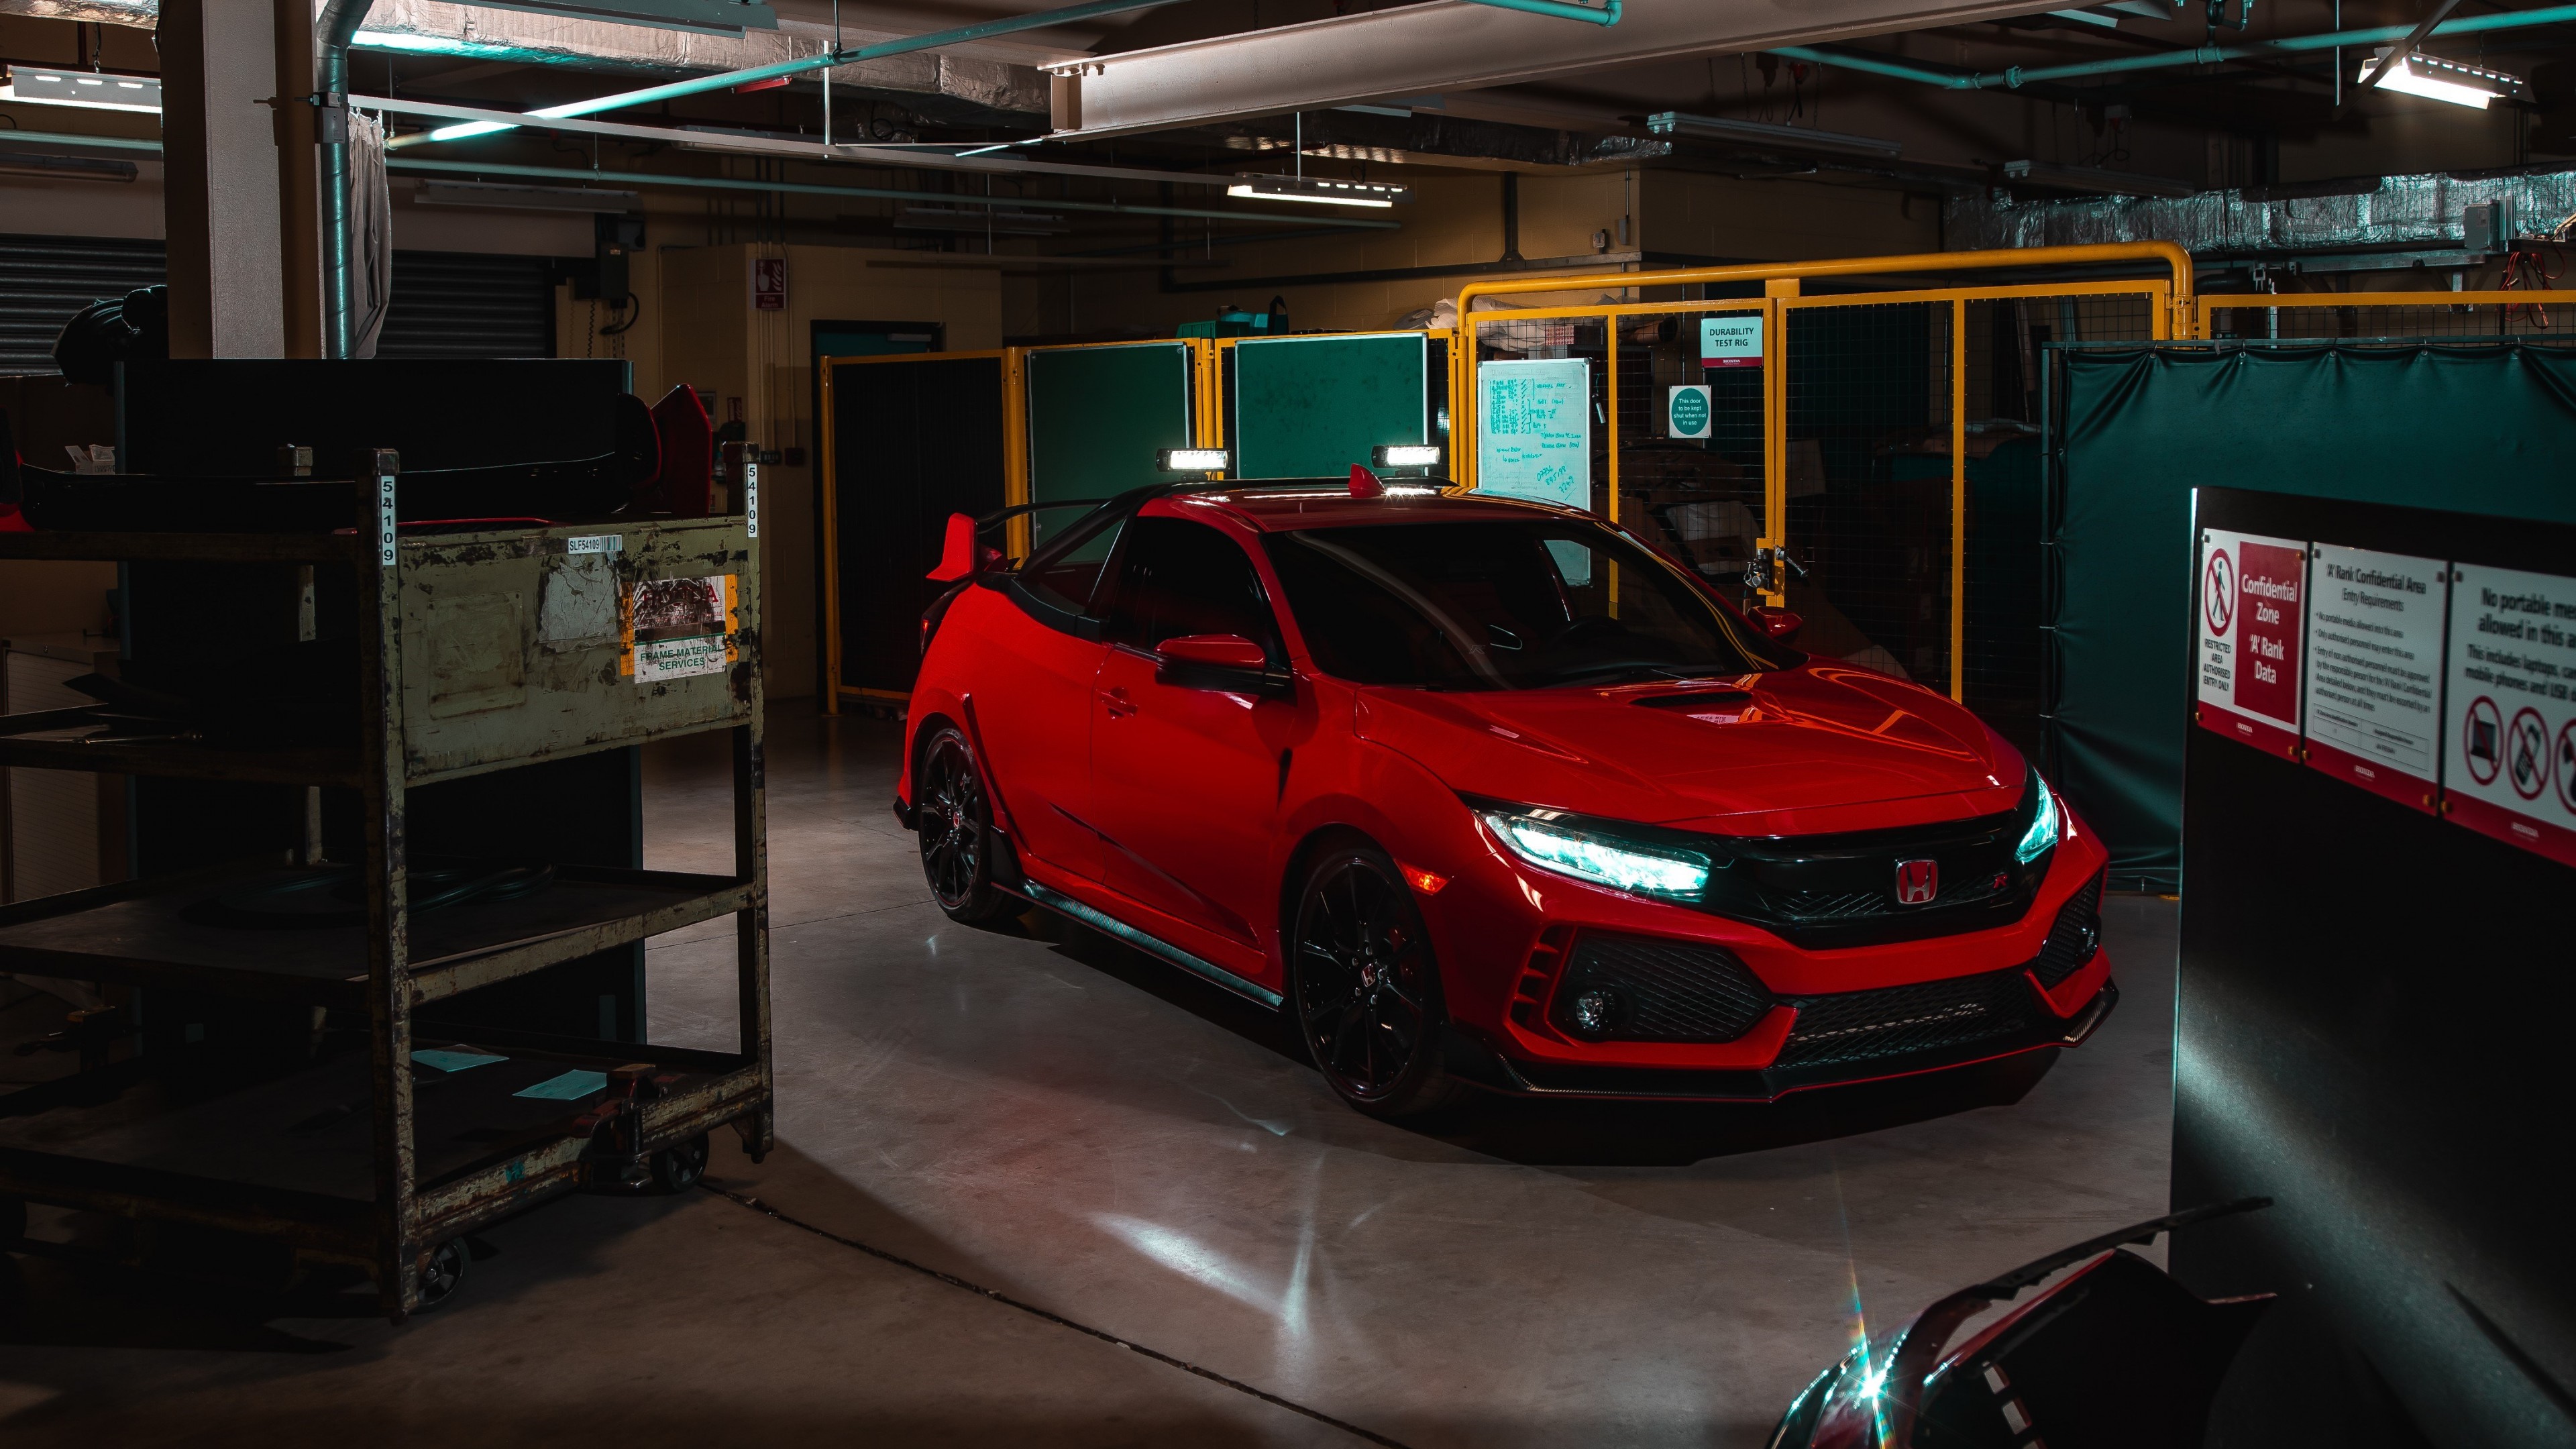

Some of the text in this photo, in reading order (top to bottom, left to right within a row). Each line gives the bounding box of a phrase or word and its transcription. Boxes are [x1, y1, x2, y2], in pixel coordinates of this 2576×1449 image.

[1709, 327, 1754, 335] DURABILITY
[748, 468, 757, 534] 54109
[382, 481, 394, 561] 54109
[569, 539, 600, 551] SLF54109
[2241, 574, 2298, 602] Confidential
[2336, 565, 2355, 582] Rank
[2356, 568, 2404, 590] Confidential
[2406, 576, 2426, 594] Area
[2341, 588, 2404, 612] Entry Requirements
[2481, 586, 2498, 608] No
[2499, 593, 2551, 616] portable
[2256, 602, 2279, 625] Zone
[2318, 611, 2325, 621] No
[2325, 614, 2343, 625] portable
[2343, 617, 2356, 628] media
[2357, 619, 2373, 631] allowed
[2384, 625, 2393, 636] this
[2478, 613, 2524, 639] allowed
[2526, 619, 2538, 641] in
[2540, 623, 2564, 647] this
[640, 644, 723, 661] FRAME MATERIAL
[2204, 639, 2231, 654] RESTRICTED
[2261, 636, 2284, 660] Rank
[2318, 628, 2415, 660] Only authorised personnel may enter this area
[2467, 643, 2485, 660] This
[2485, 647, 2521, 668] includes
[659, 657, 706, 671] SERVICES
[2203, 663, 2231, 679] AUTHORISED
[2211, 653, 2223, 665] AREA
[2317, 645, 2328, 659] Entry
[2328, 649, 2334, 658] of
[2341, 653, 2365, 667] authorised
[2365, 660, 2387, 672] personnel
[2388, 665, 2400, 676] must
[2400, 667, 2407, 676] be
[2203, 675, 2230, 692] ENTRY ONLY
[2254, 660, 2277, 684] Data
[2317, 658, 2322, 670] by
[2330, 664, 2353, 678] responsible
[2353, 671, 2368, 682] person
[2376, 674, 2384, 686] the
[2391, 679, 2402, 691] Rank
[2403, 682, 2432, 699] Confidential
[2465, 666, 2494, 683] mobile
[2494, 671, 2528, 691] phones
[2530, 680, 2548, 695] and
[2316, 672, 2326, 683] Area
[2326, 675, 2343, 688] detailed
[2357, 684, 2366, 694] and
[2367, 687, 2376, 699] they
[2316, 687, 2337, 700] authorised
[2337, 694, 2351, 705] person
[2237, 722, 2253, 733] HONDA
[2354, 765, 2375, 778] HONDA
[1993, 873, 2008, 889] R
